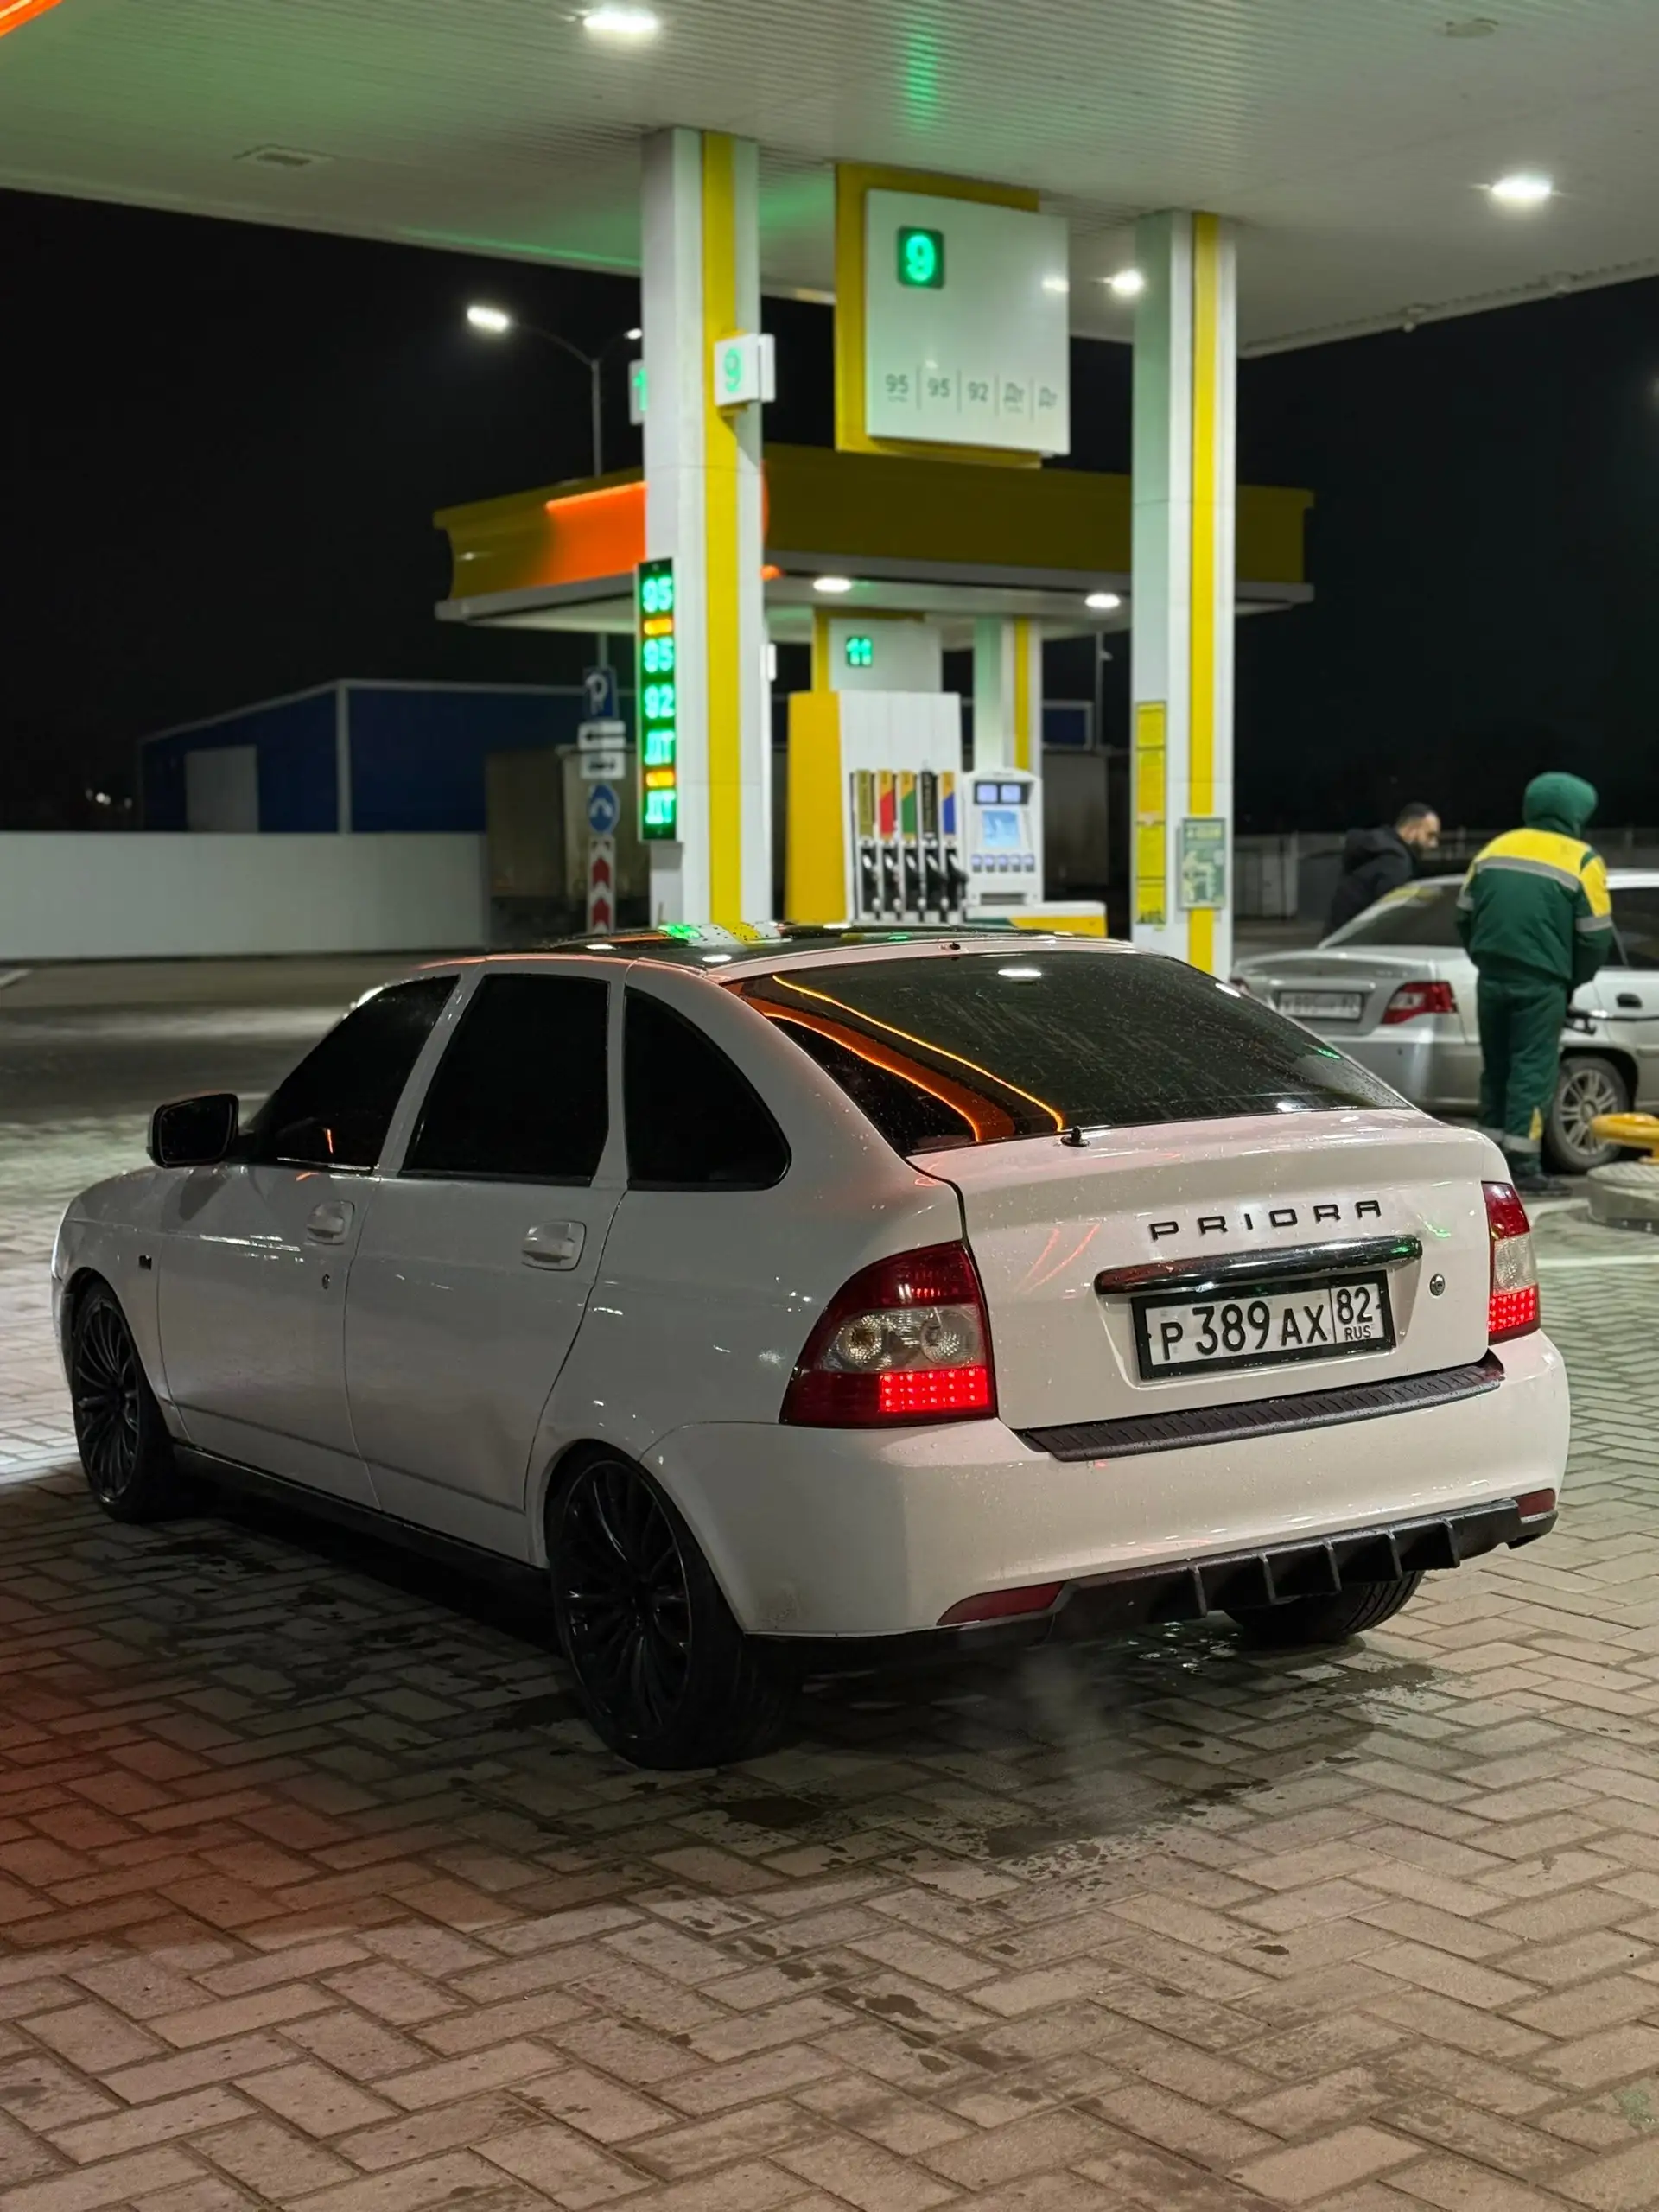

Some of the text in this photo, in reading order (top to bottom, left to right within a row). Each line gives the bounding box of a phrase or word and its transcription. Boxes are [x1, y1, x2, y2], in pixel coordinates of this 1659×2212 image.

[906, 235, 935, 282] 9
[723, 348, 741, 393] 9
[885, 373, 908, 394] 95
[927, 377, 950, 398] 95
[967, 381, 989, 402] 92
[642, 575, 673, 613] 95
[846, 638, 871, 665] 11
[645, 684, 675, 719] 92
[1149, 1199, 1382, 1242] PRIORA
[1337, 1286, 1373, 1325] 82
[1344, 1324, 1372, 1341] RUS
